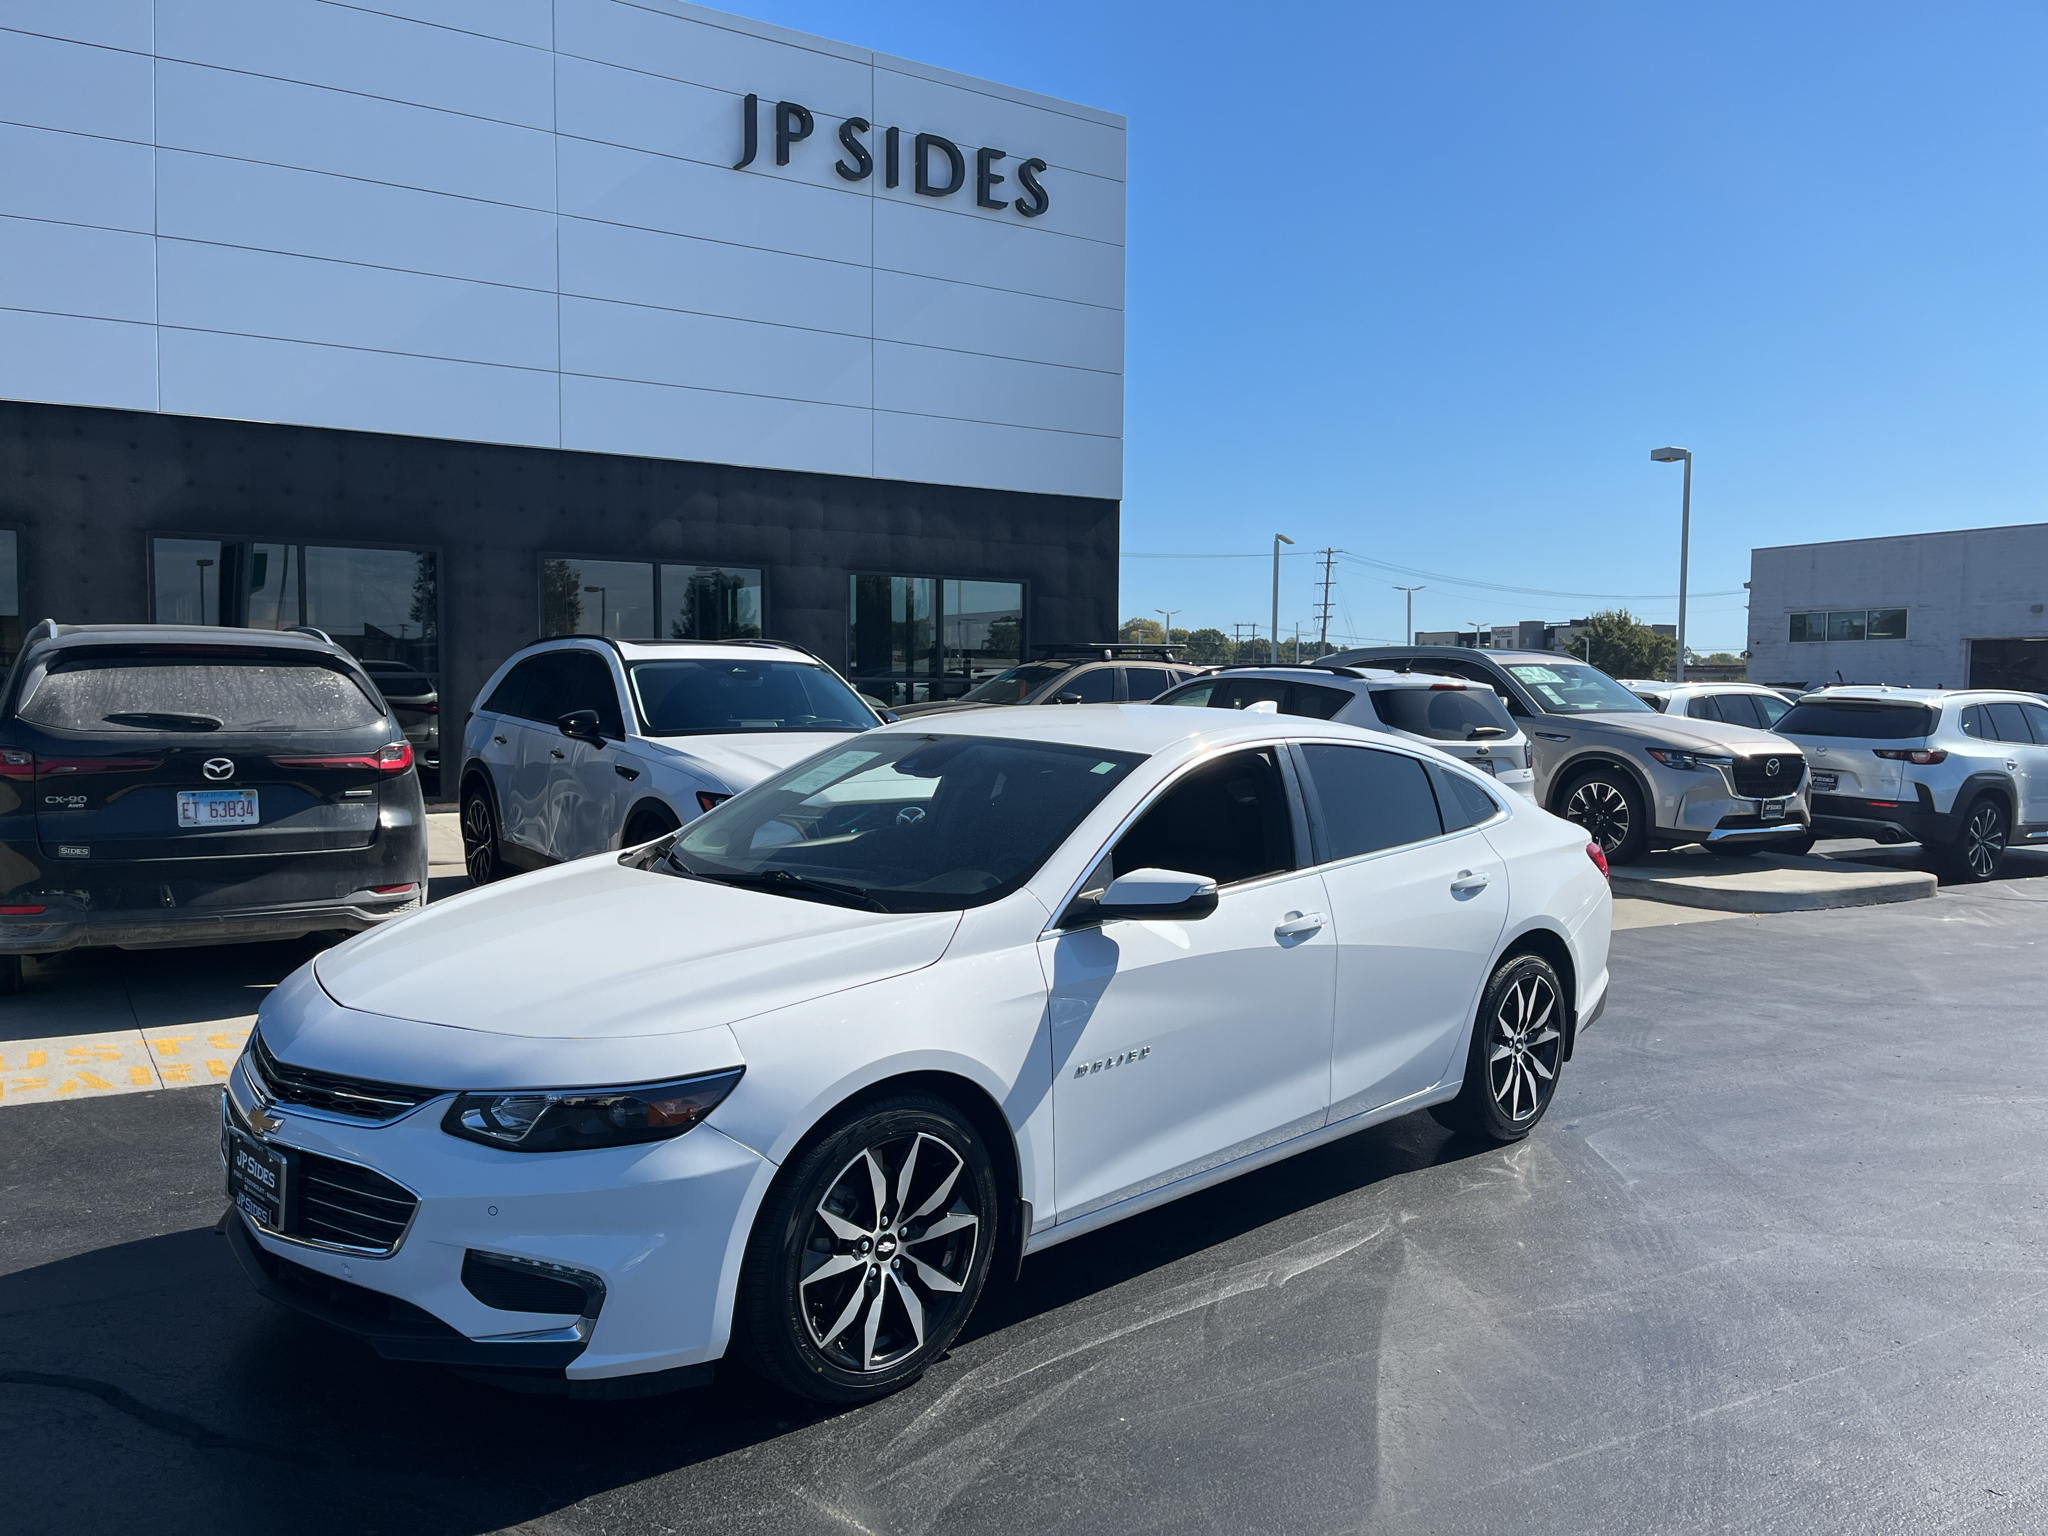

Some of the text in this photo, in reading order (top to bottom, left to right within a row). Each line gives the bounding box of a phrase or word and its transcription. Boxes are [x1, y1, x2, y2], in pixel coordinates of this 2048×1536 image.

[733, 93, 1050, 218] JP SIDES
[45, 795, 87, 803] CX-90
[182, 799, 254, 819] ET 63834
[60, 847, 89, 855] SIDES
[237, 1150, 275, 1189] JP SIDES
[237, 1192, 245, 1207] JP
[245, 1197, 268, 1224] SIDES
